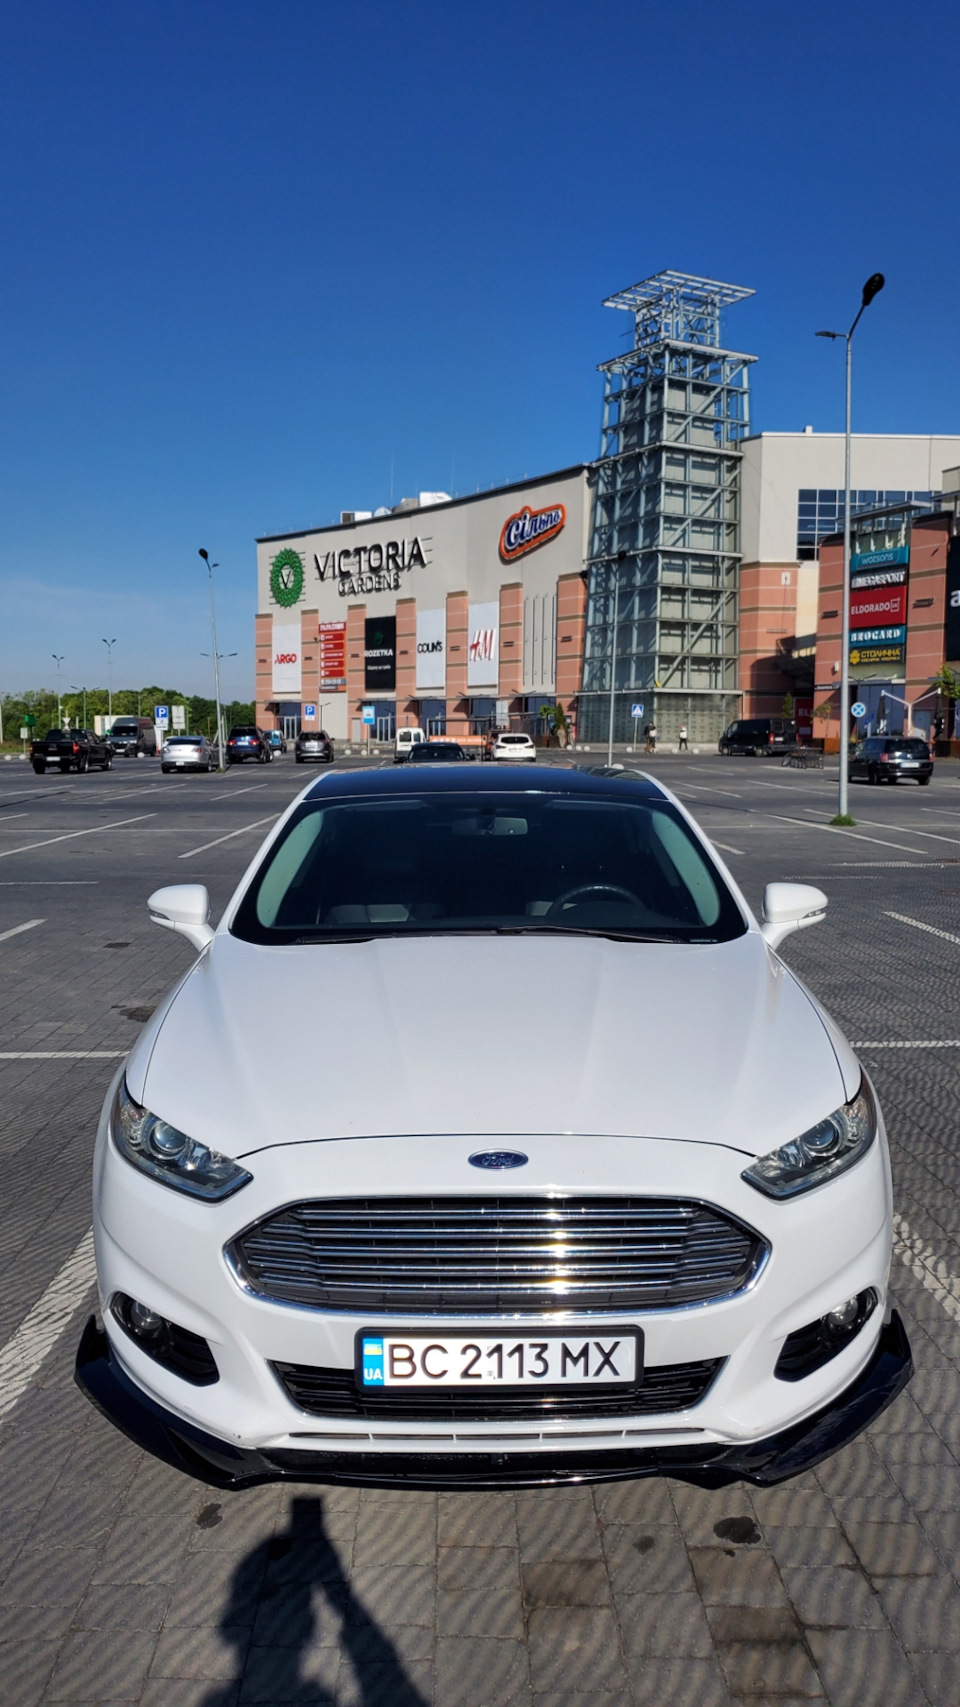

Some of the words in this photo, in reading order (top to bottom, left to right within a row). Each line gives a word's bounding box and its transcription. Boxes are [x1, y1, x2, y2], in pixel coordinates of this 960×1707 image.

[505, 511, 561, 549] Сільпо
[314, 536, 427, 581] VICTORIA
[861, 553, 894, 565] watsons
[338, 572, 401, 597] GARDENS
[856, 571, 905, 587] MEGASPORT
[851, 602, 890, 614] ELDORADO
[851, 629, 902, 641] BROGARD
[364, 649, 393, 658] ROZETKA
[417, 641, 442, 654] COLIN'S
[861, 648, 901, 658] СТОЛИЧНА
[274, 653, 297, 664] ARGO
[159, 708, 166, 717] P
[307, 706, 313, 714] P
[481, 1153, 515, 1166] Ford
[388, 1343, 449, 1379] BC
[460, 1343, 549, 1379] 2113
[561, 1341, 621, 1378] MX
[363, 1368, 383, 1380] UA
